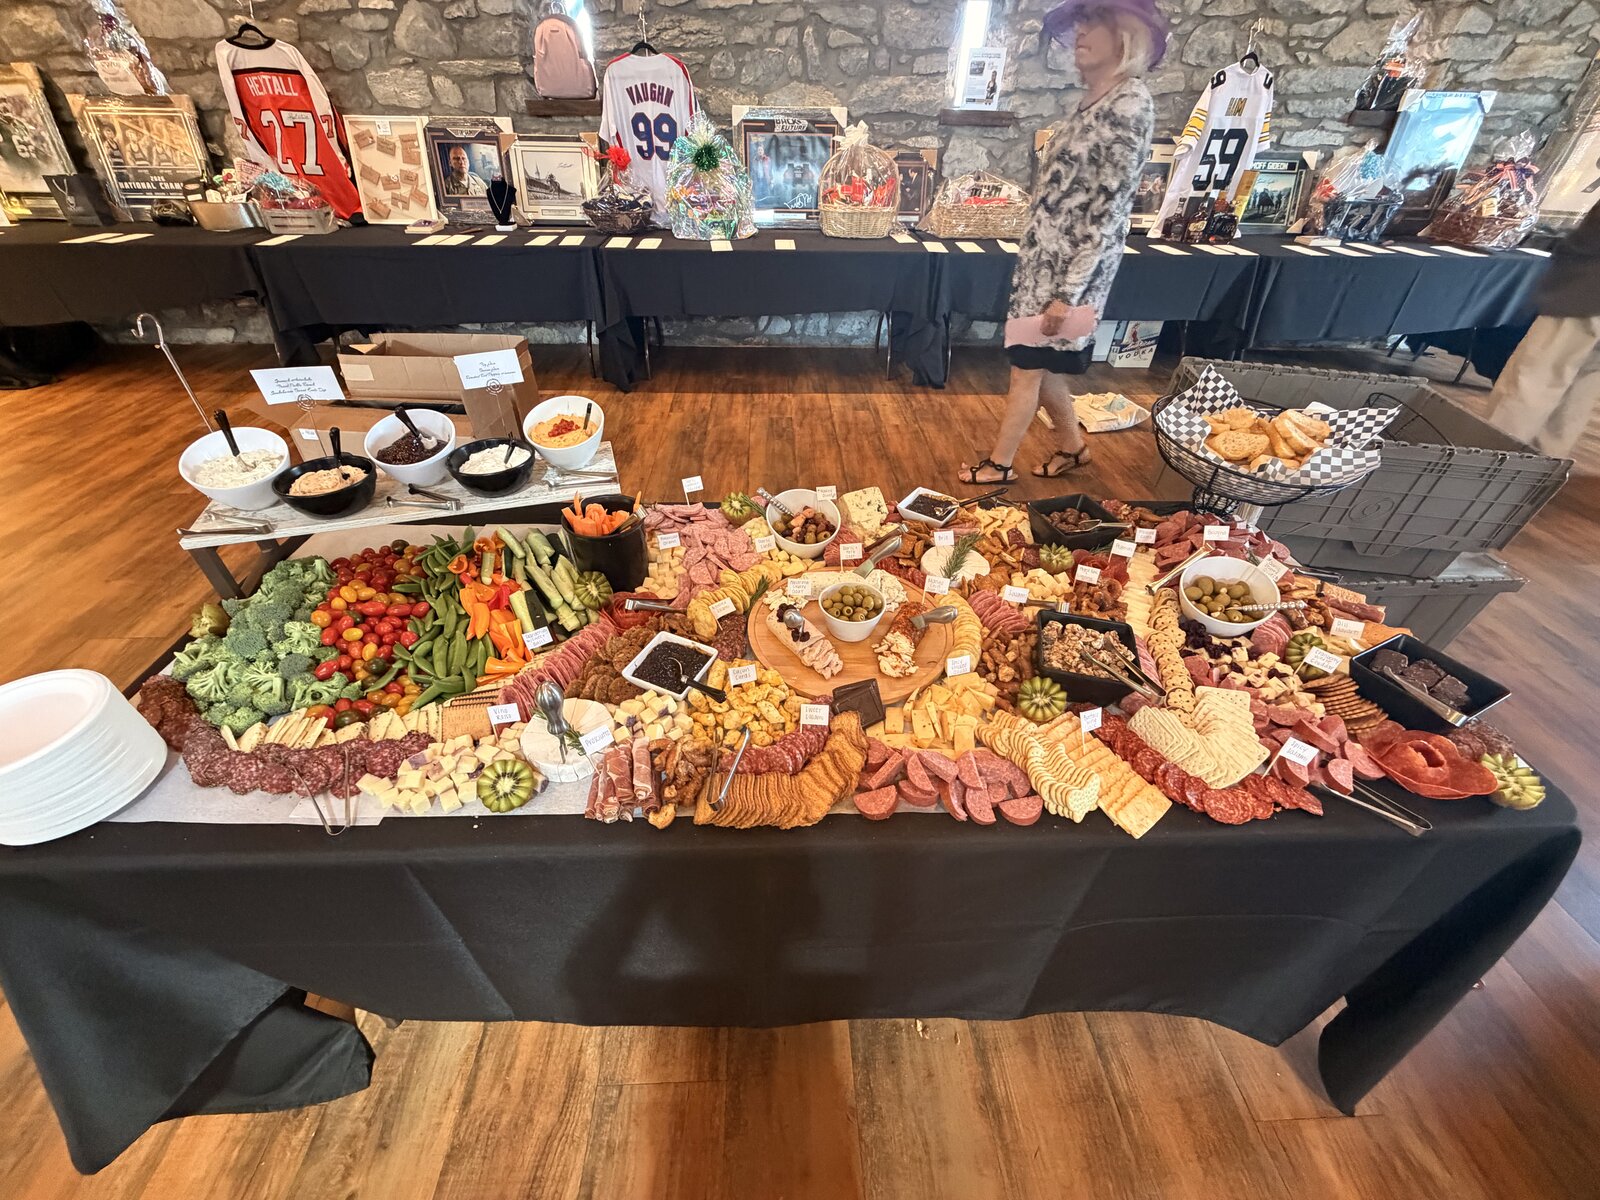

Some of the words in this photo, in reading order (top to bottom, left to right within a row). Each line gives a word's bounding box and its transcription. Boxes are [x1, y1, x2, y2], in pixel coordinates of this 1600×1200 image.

[626, 82, 674, 108] VAUGHN
[260, 108, 326, 175] 27
[631, 111, 678, 162] 99
[1192, 128, 1249, 191] 59
[119, 181, 157, 190] NATIONAL
[158, 182, 184, 190] CHAM
[1118, 348, 1153, 360] VODKA
